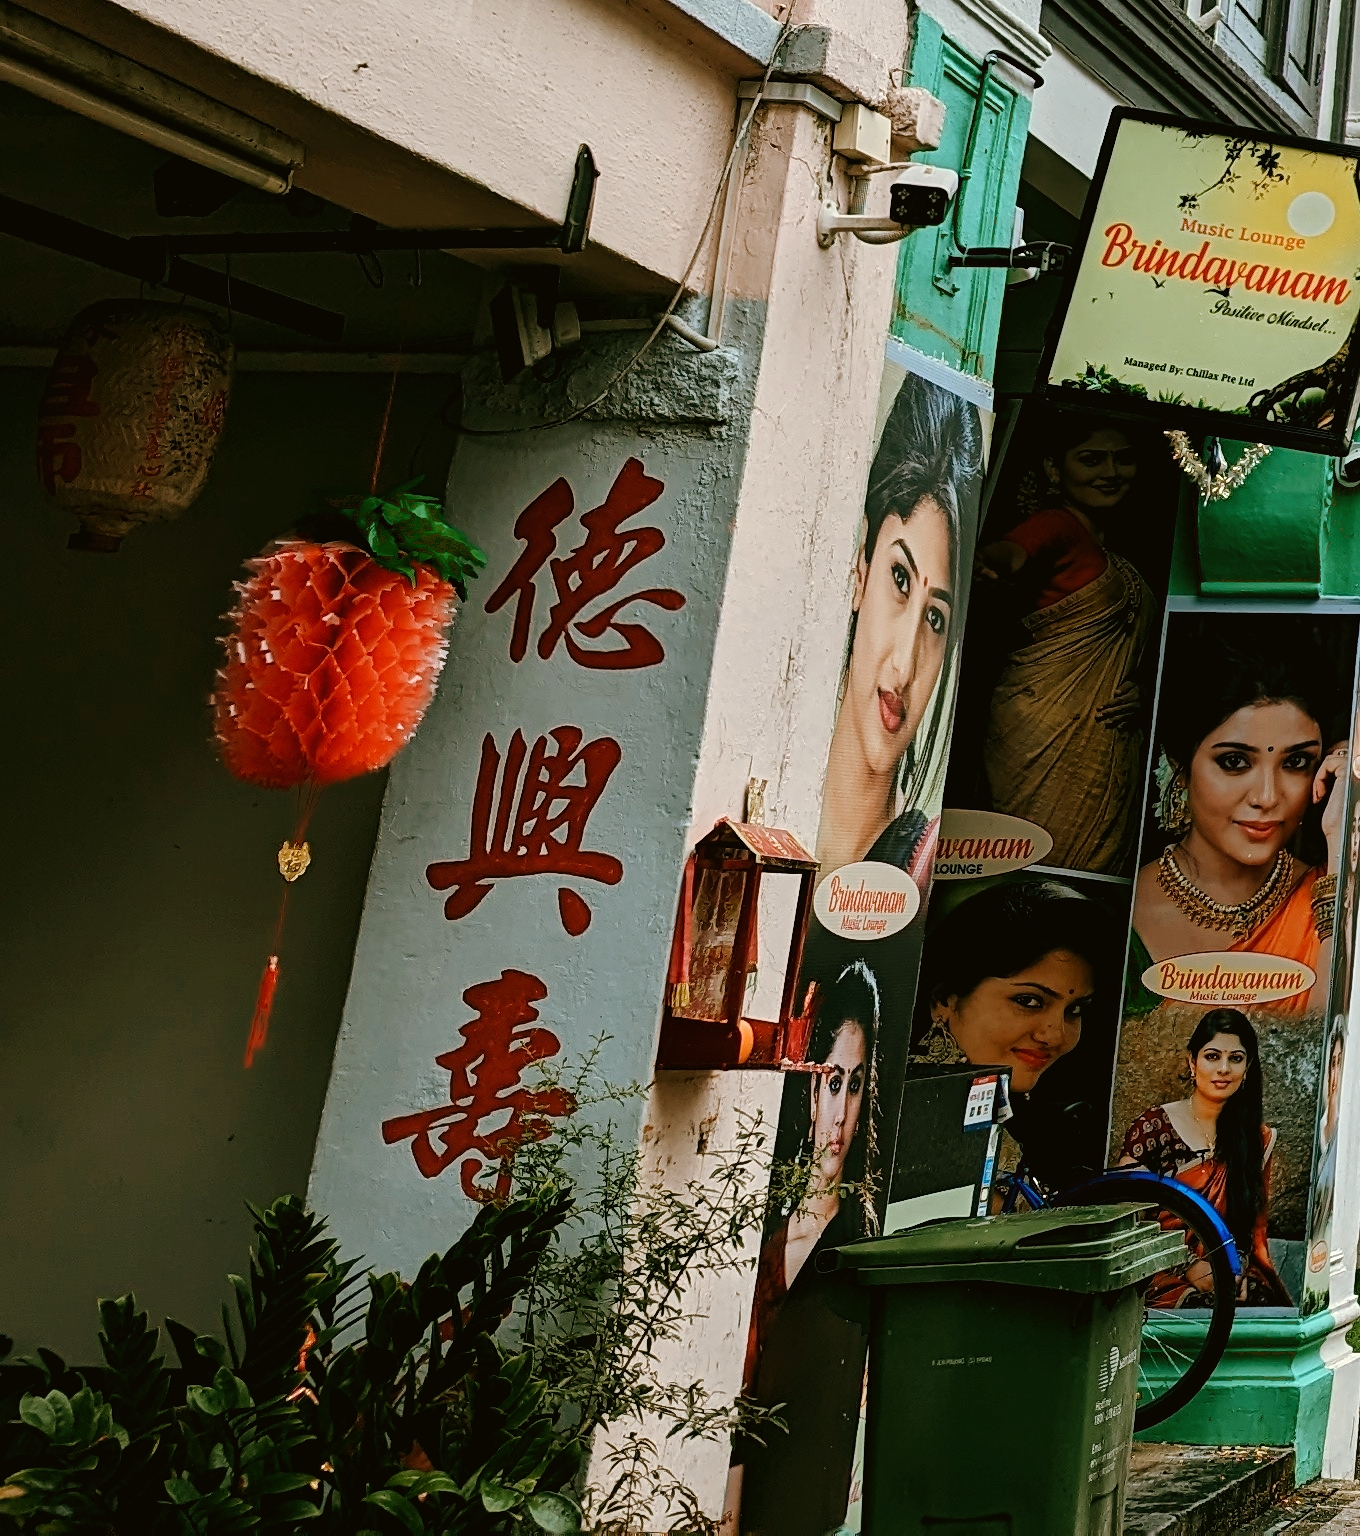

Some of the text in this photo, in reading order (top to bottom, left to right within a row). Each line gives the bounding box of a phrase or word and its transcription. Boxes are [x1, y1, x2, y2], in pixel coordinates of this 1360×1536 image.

[1180, 218, 1306, 251] Music Lounge
[1101, 223, 1352, 305] Brindavanam
[1209, 299, 1265, 322] Positive
[1124, 357, 1255, 387] Managed By: Chillax Pte Ltd
[935, 864, 983, 875] LOUNGE
[829, 875, 908, 914] Brindavanam
[841, 915, 888, 935] Music Lounge
[1160, 963, 1305, 991] Brindavanam
[1190, 990, 1257, 1003] Music Lounge
